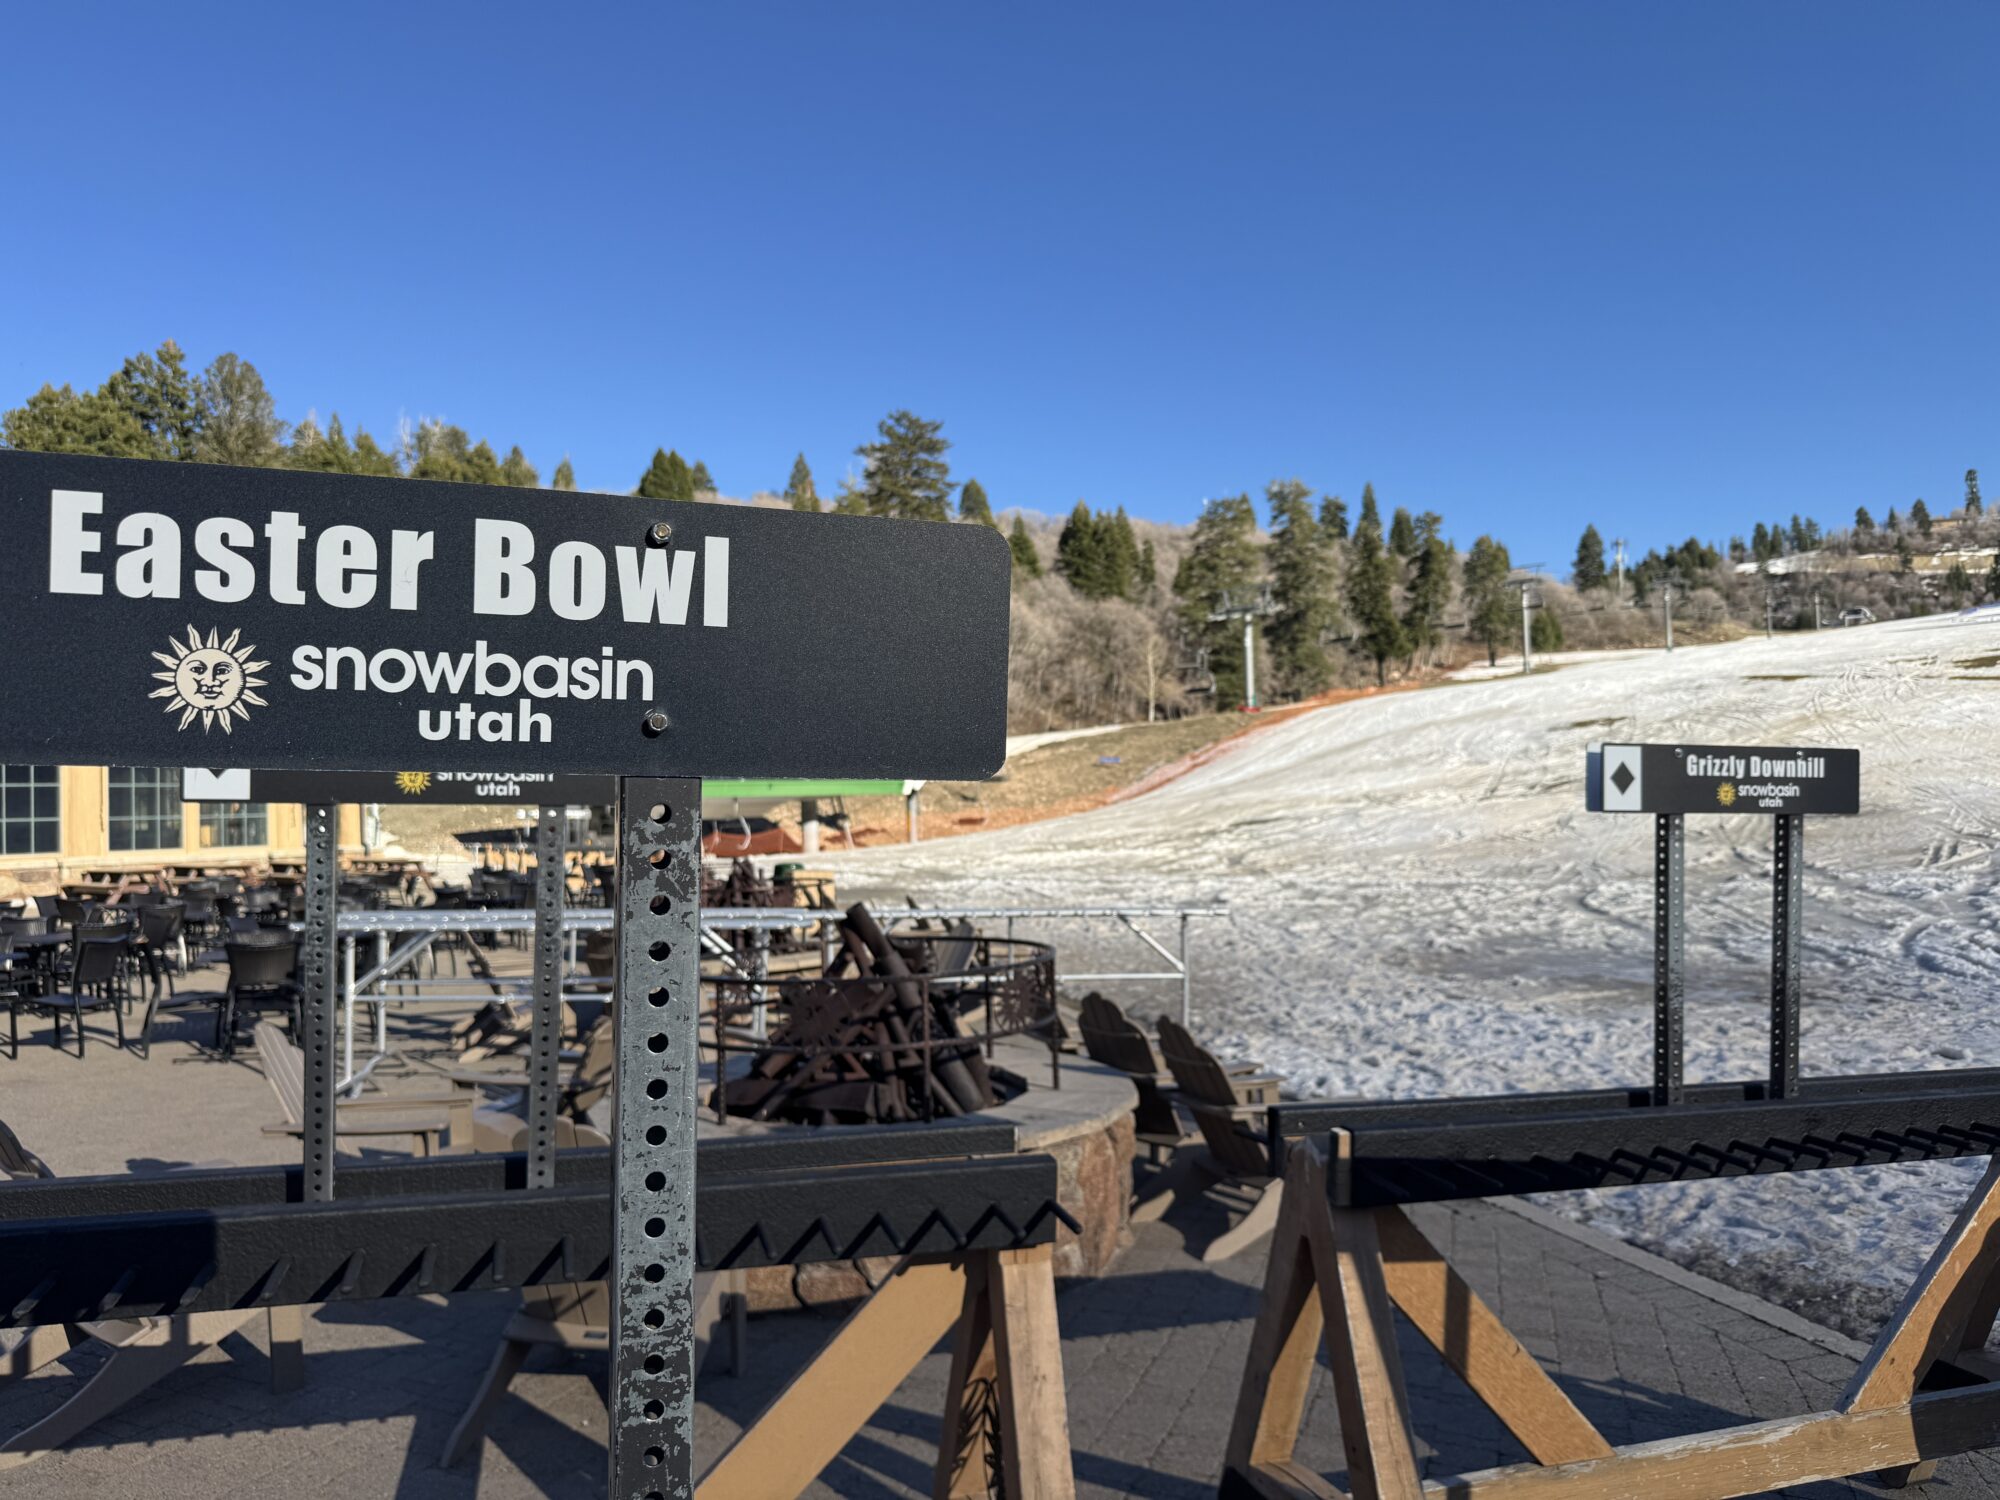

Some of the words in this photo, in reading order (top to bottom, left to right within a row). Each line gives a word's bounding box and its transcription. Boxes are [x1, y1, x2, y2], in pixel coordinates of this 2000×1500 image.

[50, 490, 434, 611] Easter
[474, 519, 729, 628] Bowl
[290, 640, 654, 701] snowbasin
[418, 699, 552, 743] utah
[1686, 754, 1746, 779] Grizzly
[1750, 755, 1825, 778] Downhill
[475, 780, 521, 796] utah
[1738, 782, 1800, 797] snowbasin
[1758, 796, 1783, 807] utah
